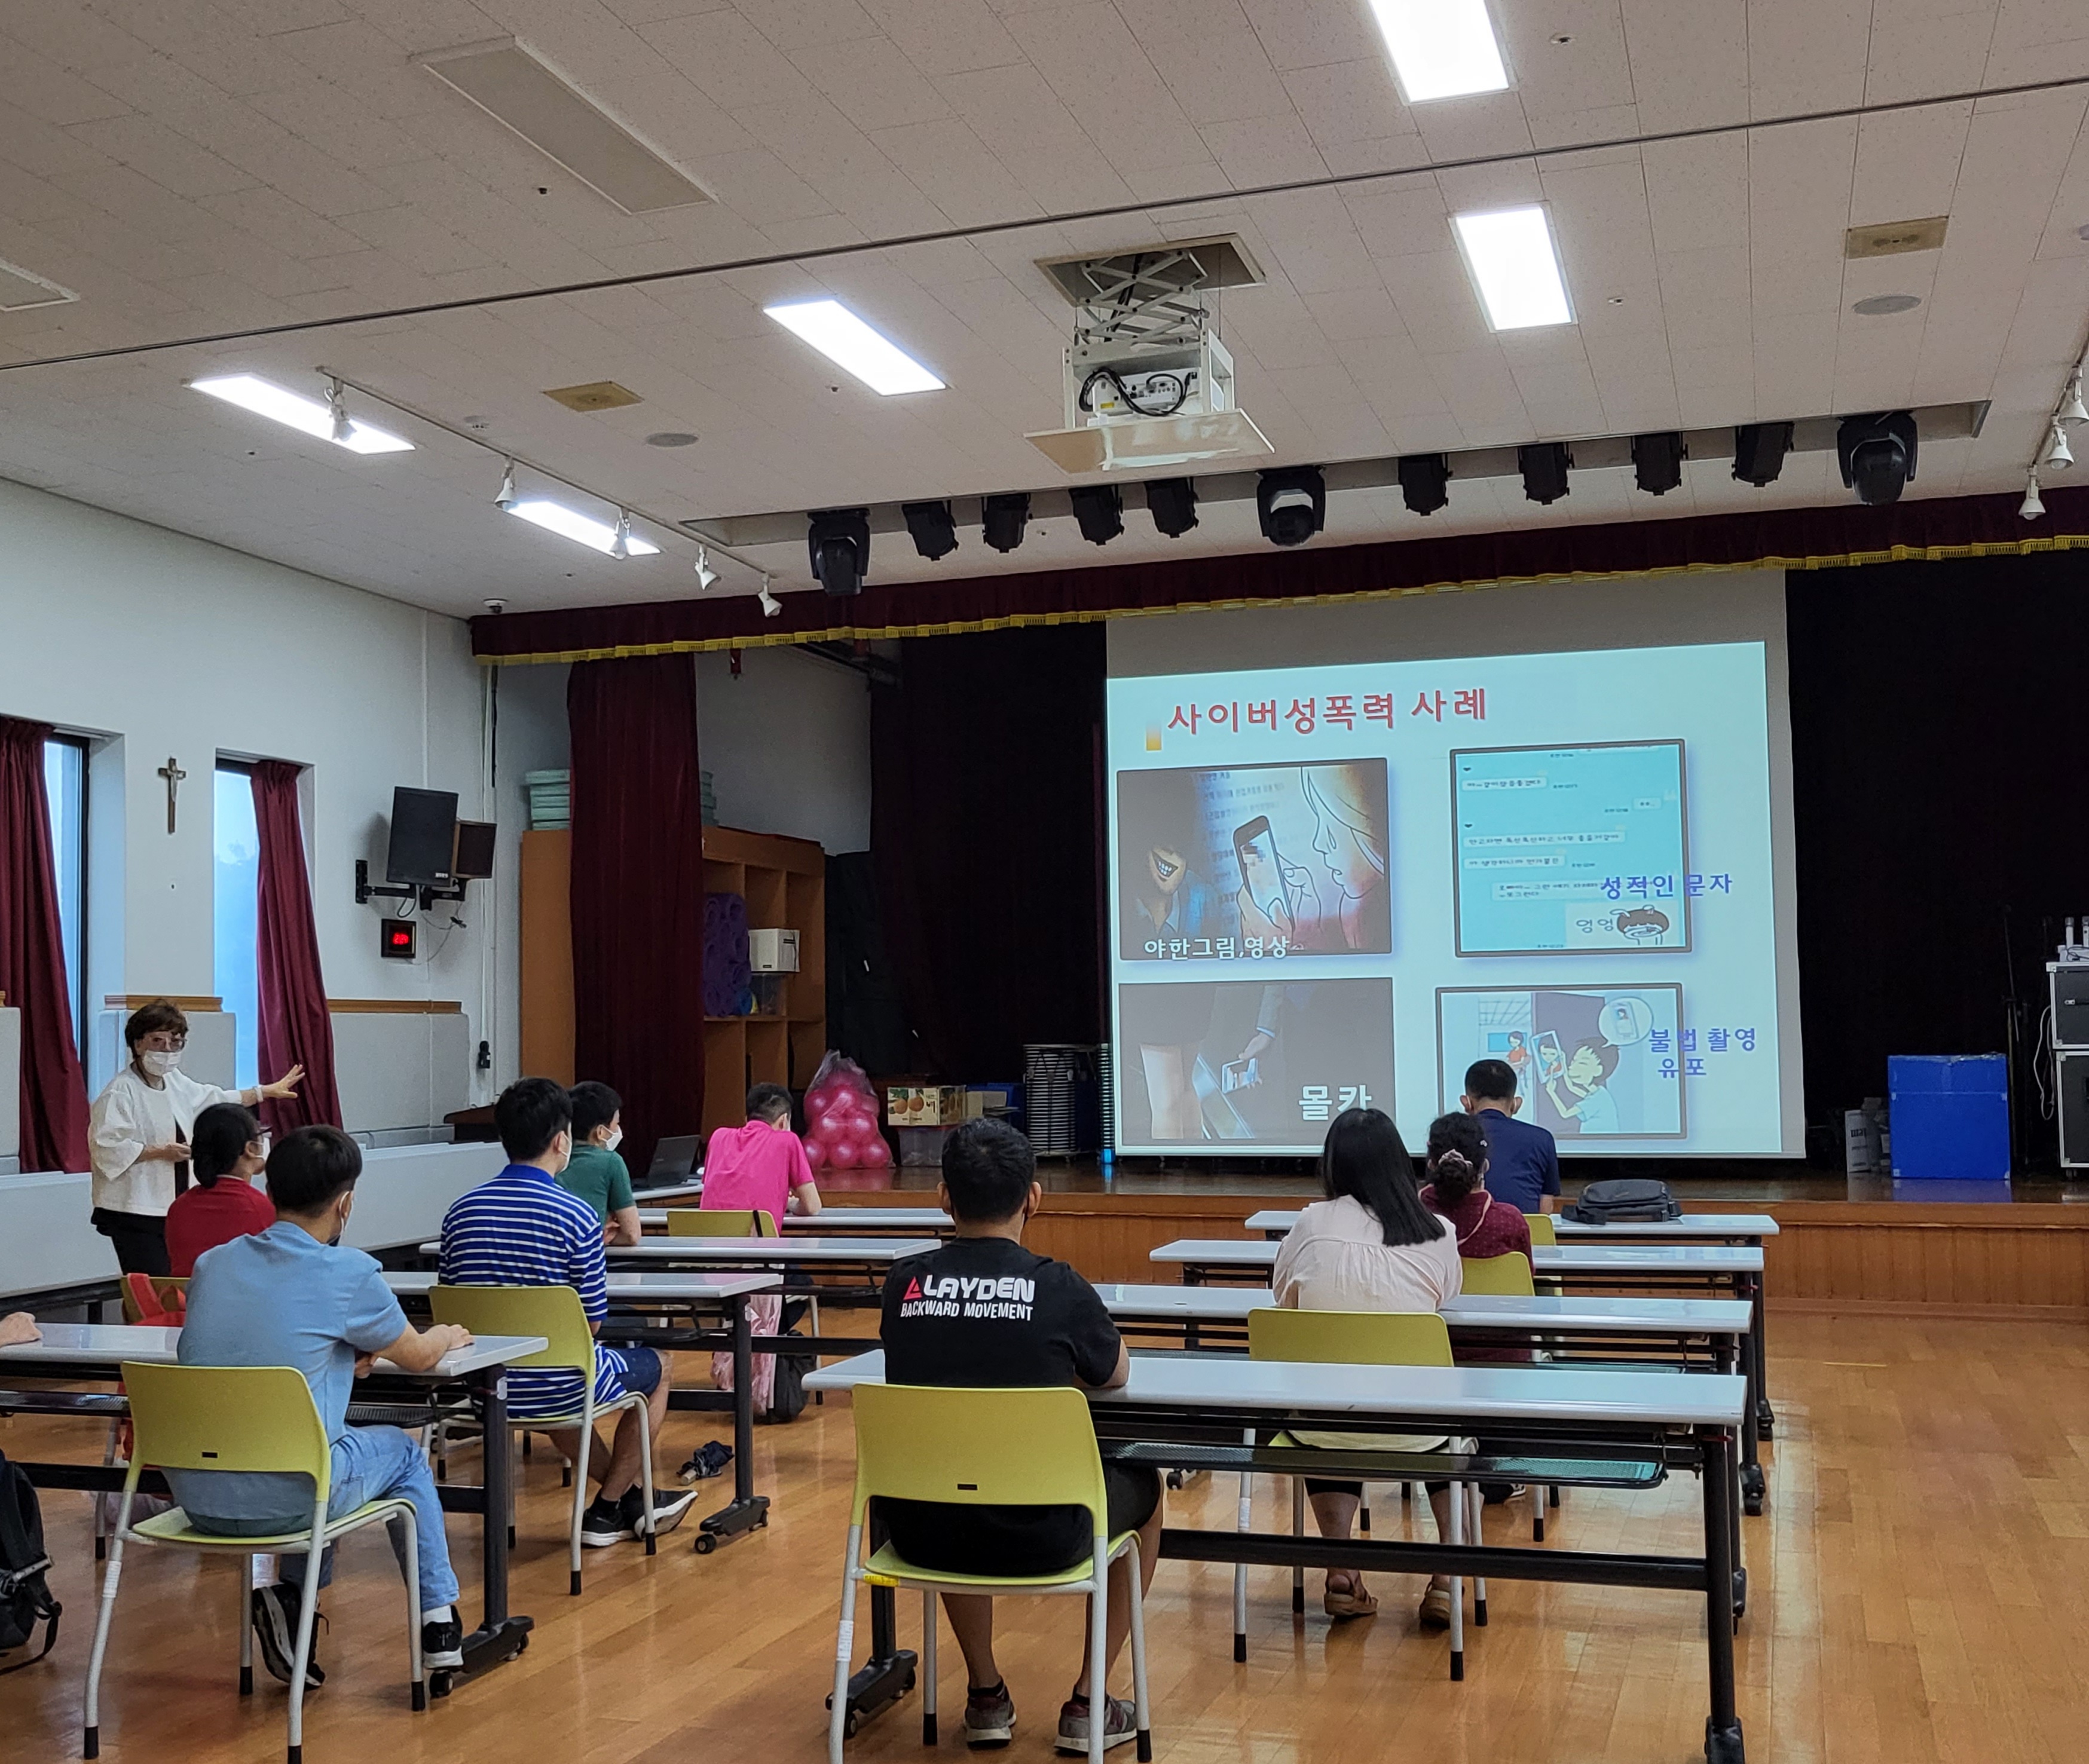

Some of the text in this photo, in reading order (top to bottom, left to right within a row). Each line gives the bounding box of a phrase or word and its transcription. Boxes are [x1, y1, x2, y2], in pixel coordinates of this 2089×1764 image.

[1167, 688, 1486, 734] 사이버성폭력 사례
[1600, 874, 1733, 900] 성적인 문자
[1144, 935, 1290, 961] 야한그림,영상
[1648, 1028, 1755, 1053] 불법 촬영
[1657, 1058, 1707, 1079] 유포
[1298, 1085, 1372, 1121] 몰카
[923, 1274, 1035, 1303] LAYDEN
[900, 1300, 1033, 1321] BACKWARD MOVEMENT
